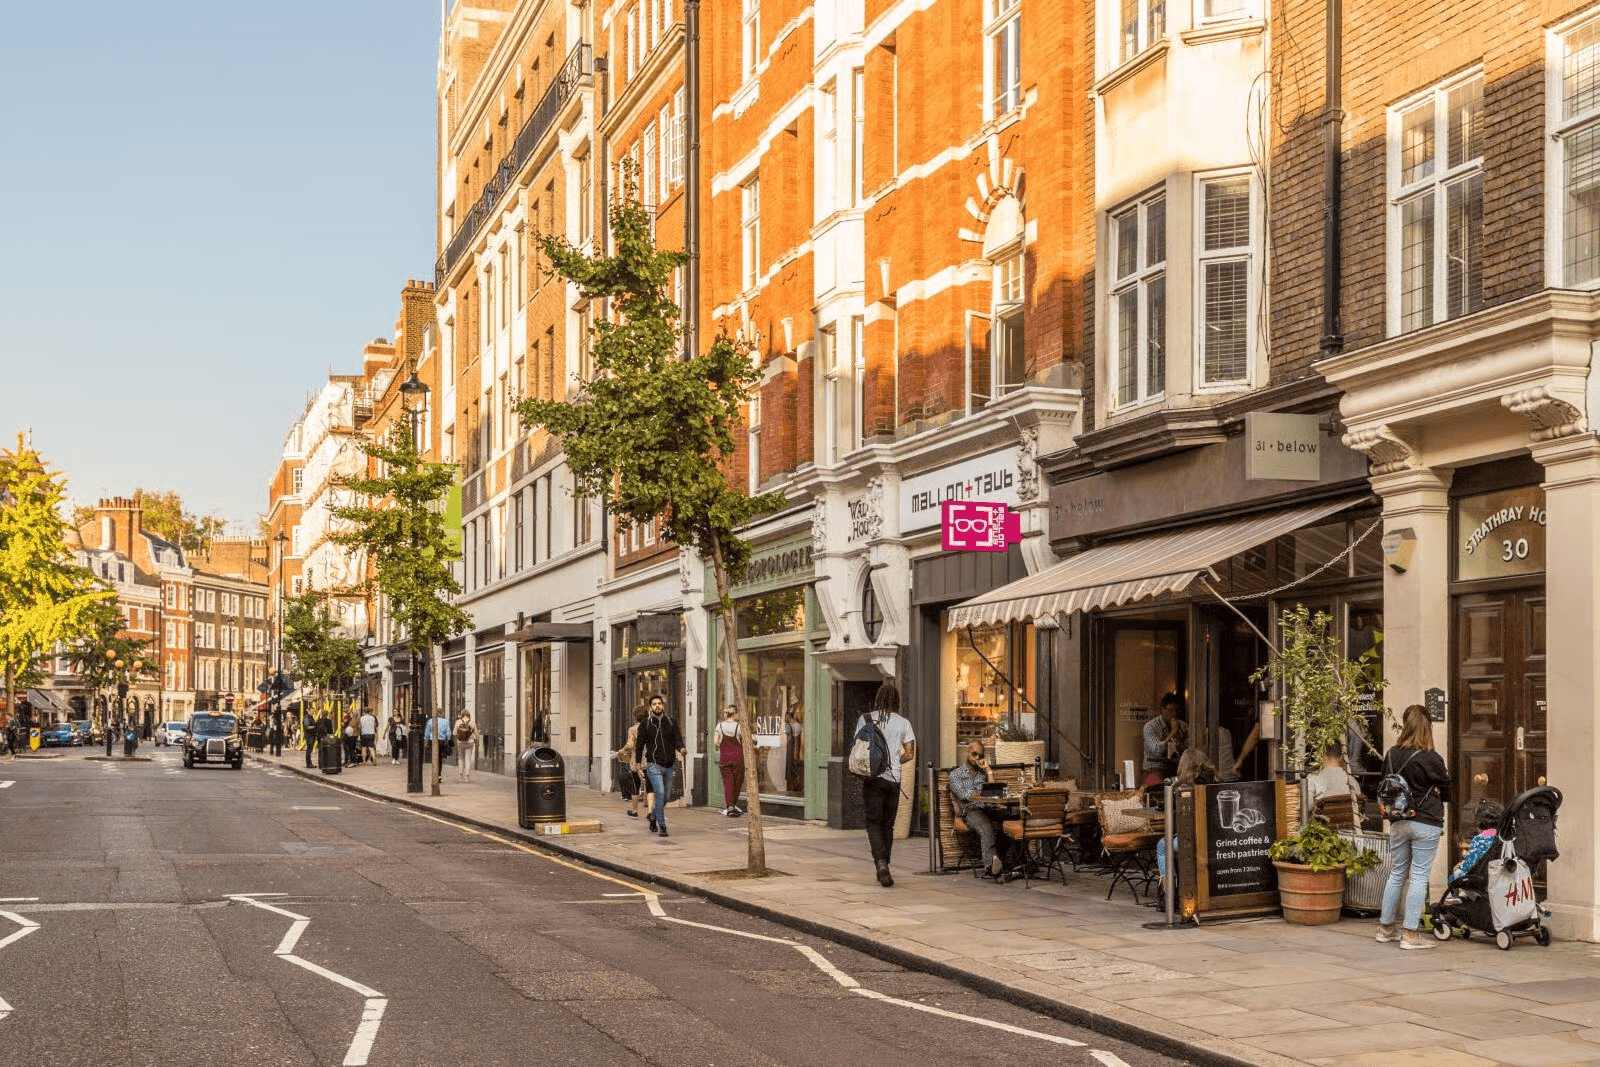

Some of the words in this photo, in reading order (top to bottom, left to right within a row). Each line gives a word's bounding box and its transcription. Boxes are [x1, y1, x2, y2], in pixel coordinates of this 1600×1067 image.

[1255, 440, 1266, 451] 31
[1277, 440, 1317, 453] below
[1464, 505, 1524, 555] STRATHRAY
[1502, 538, 1529, 561] 30
[756, 715, 781, 735] SALE
[1215, 839, 1238, 848] Grind
[1239, 836, 1263, 846] coffee
[1264, 835, 1270, 844] &
[1216, 850, 1237, 860] fresh
[1237, 848, 1269, 860] pastries
[1504, 876, 1533, 907] H&M
